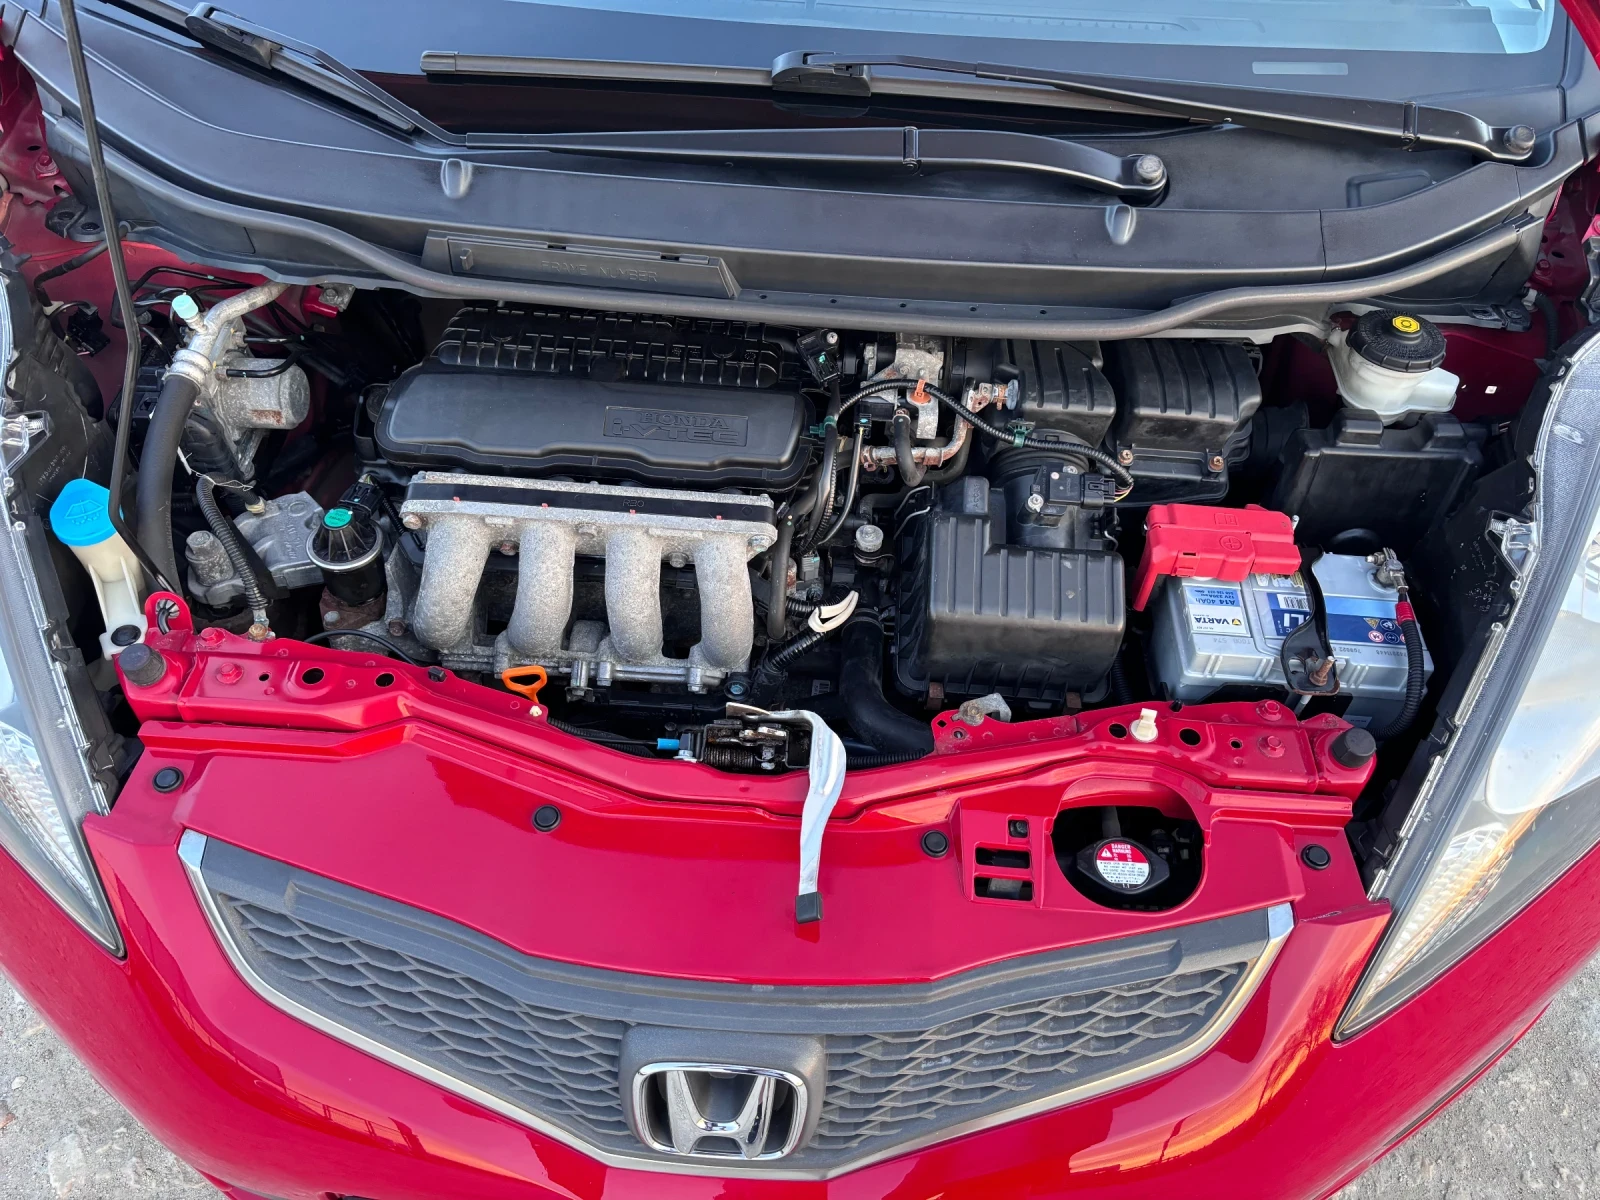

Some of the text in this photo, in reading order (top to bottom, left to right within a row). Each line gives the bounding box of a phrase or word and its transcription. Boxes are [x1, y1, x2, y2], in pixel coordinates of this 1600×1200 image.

[541, 260, 658, 283] FRAME NUMBER
[638, 411, 730, 429] HONDA
[612, 418, 739, 444] i-VTEC
[1194, 616, 1230, 625] VARTA
